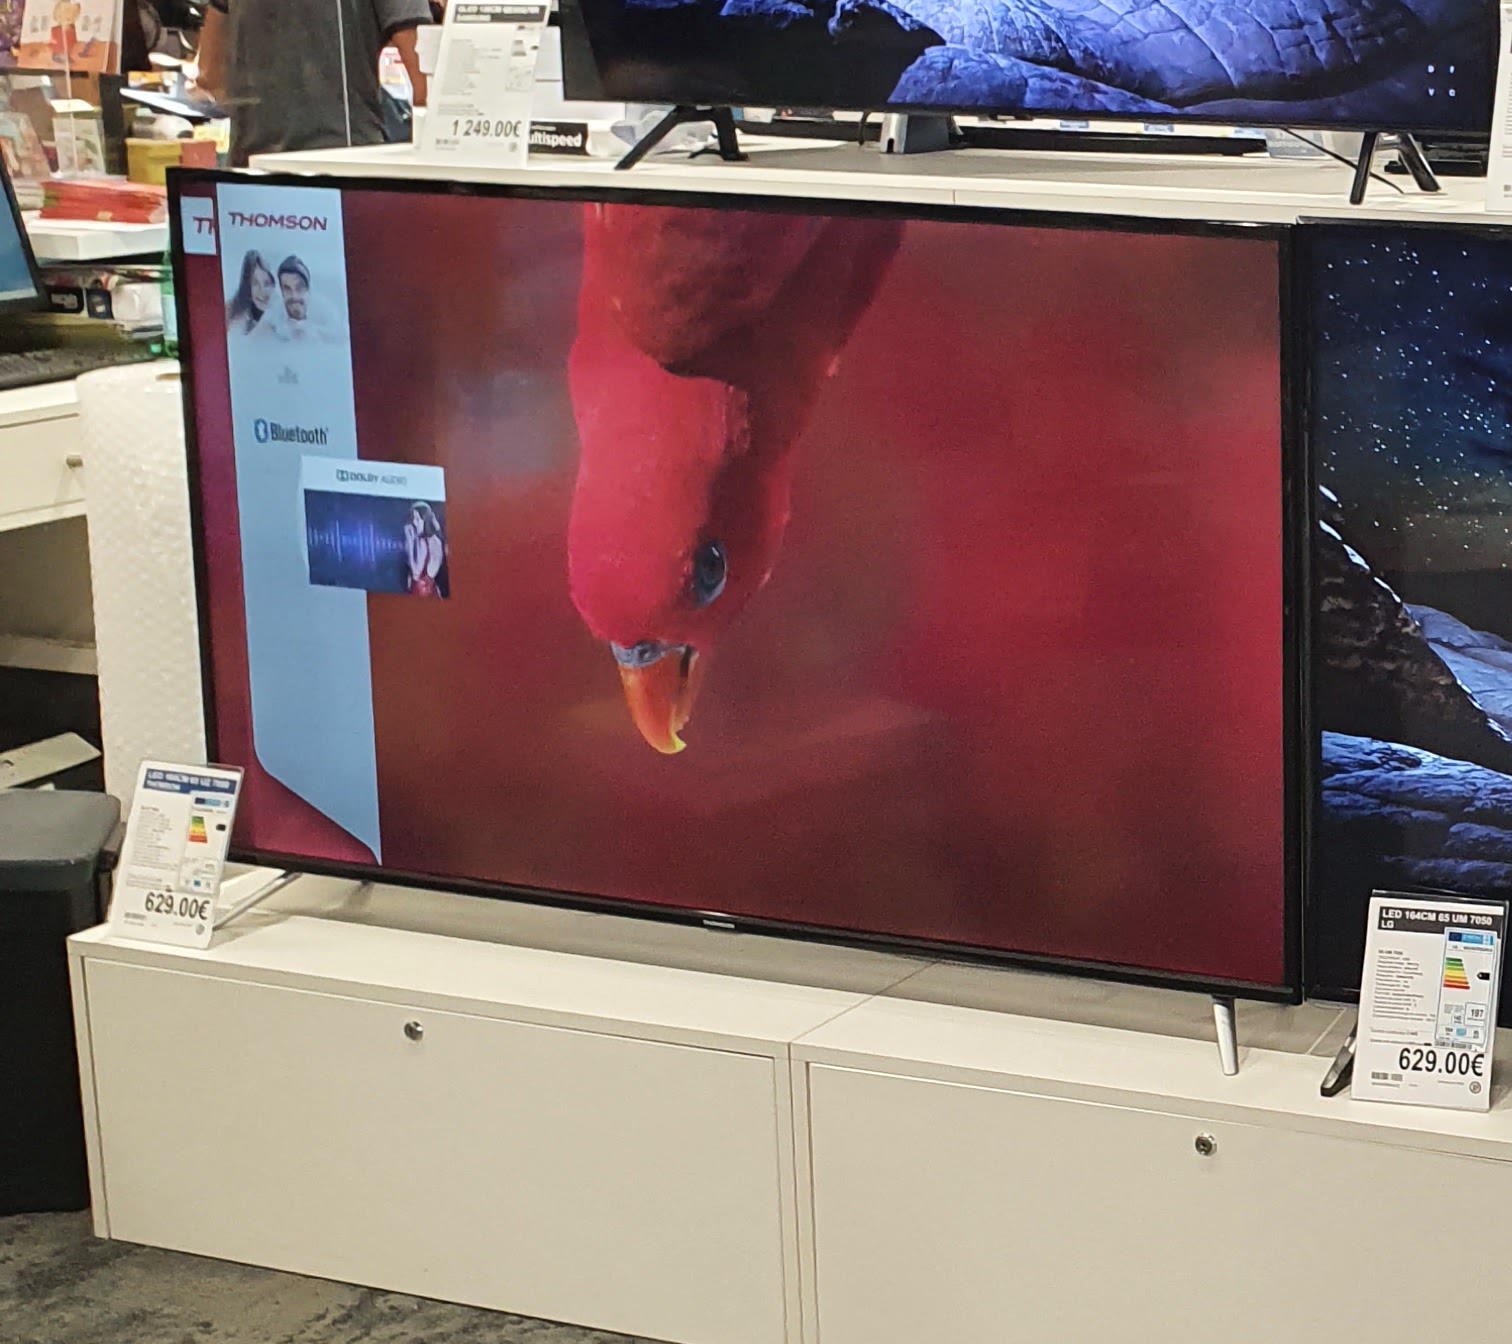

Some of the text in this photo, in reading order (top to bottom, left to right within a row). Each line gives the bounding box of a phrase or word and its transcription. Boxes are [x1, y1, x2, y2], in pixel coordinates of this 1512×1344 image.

[452, 120, 522, 138] 1 249.00€
[228, 212, 327, 231] THOMSON
[270, 422, 328, 445] Bluetooth
[145, 891, 211, 921] 629.00€
[1381, 919, 1394, 928] LG
[1382, 909, 1402, 918] LED
[1452, 914, 1468, 923] UM
[1399, 1047, 1484, 1077] 629.00€
